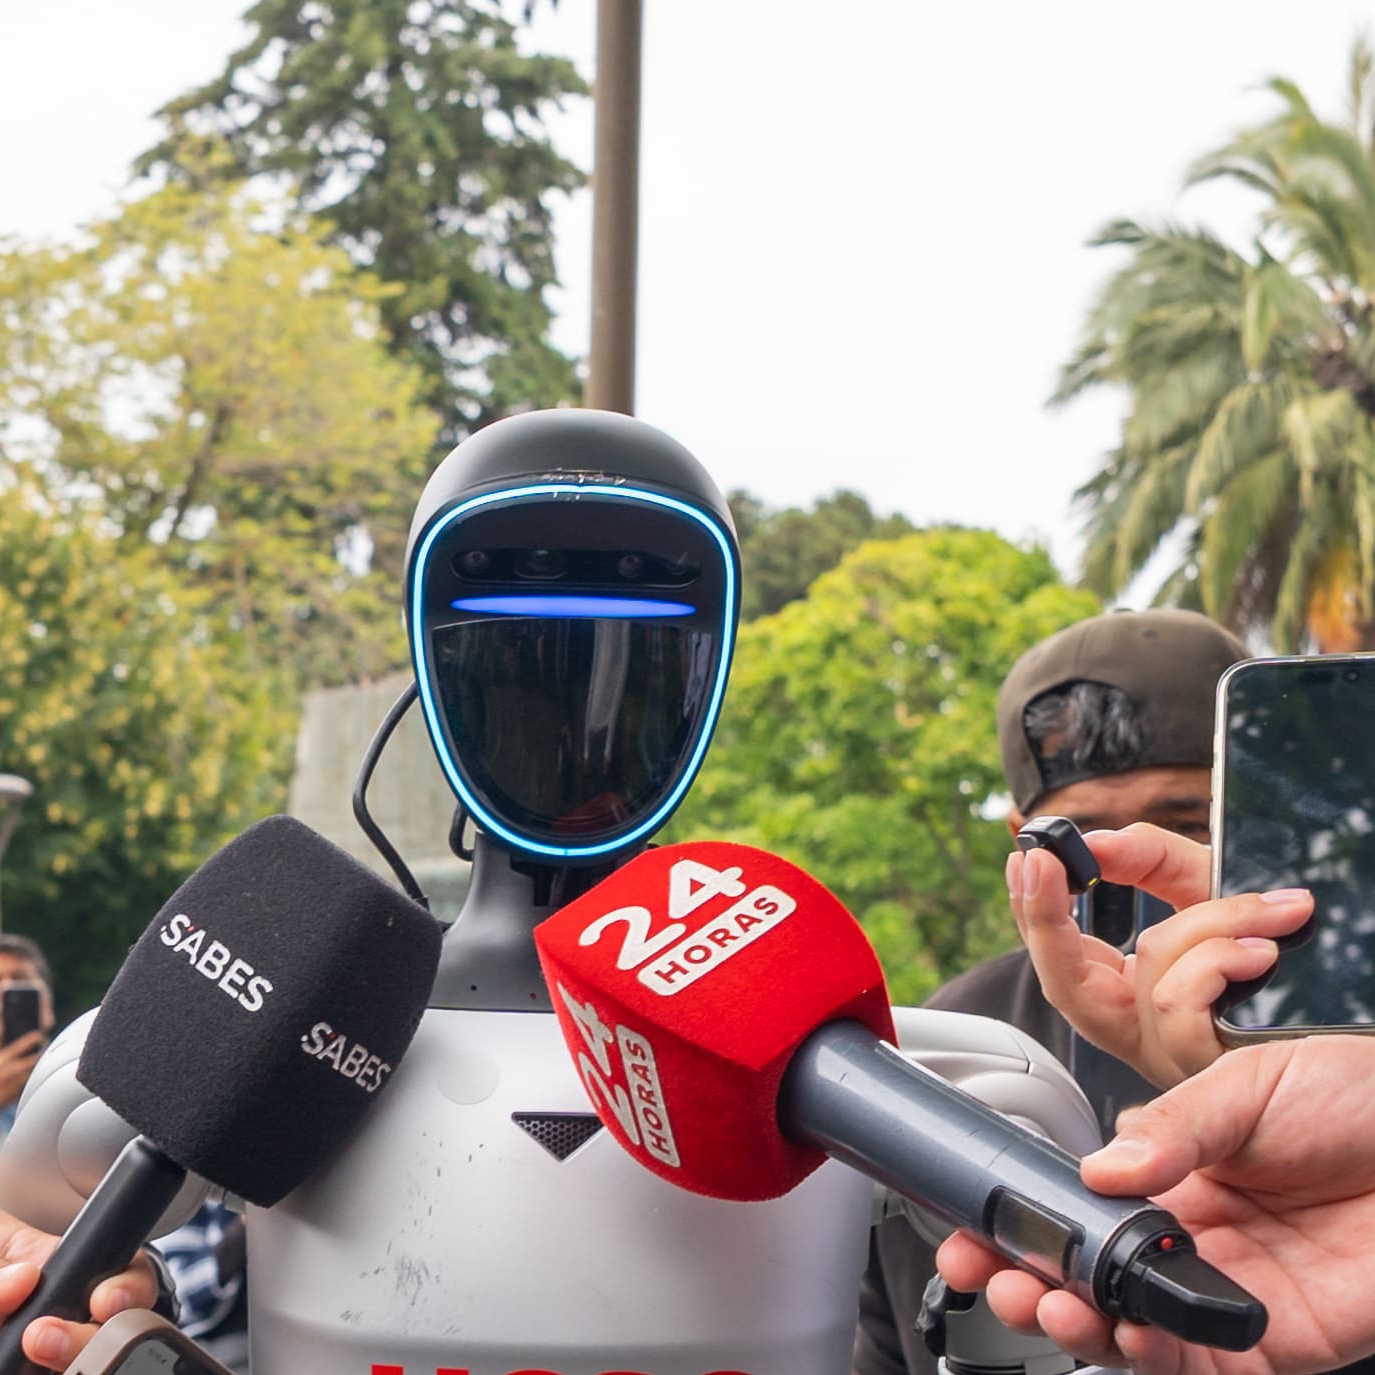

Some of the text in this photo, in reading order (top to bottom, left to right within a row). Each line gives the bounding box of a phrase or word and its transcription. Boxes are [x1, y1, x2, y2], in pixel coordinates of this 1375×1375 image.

[160, 913, 274, 1012] SABES
[578, 859, 747, 972] 24
[653, 896, 780, 985] HORAS
[299, 1021, 392, 1093] SABES
[557, 982, 642, 1147] 24
[626, 1037, 667, 1155] HORAS
